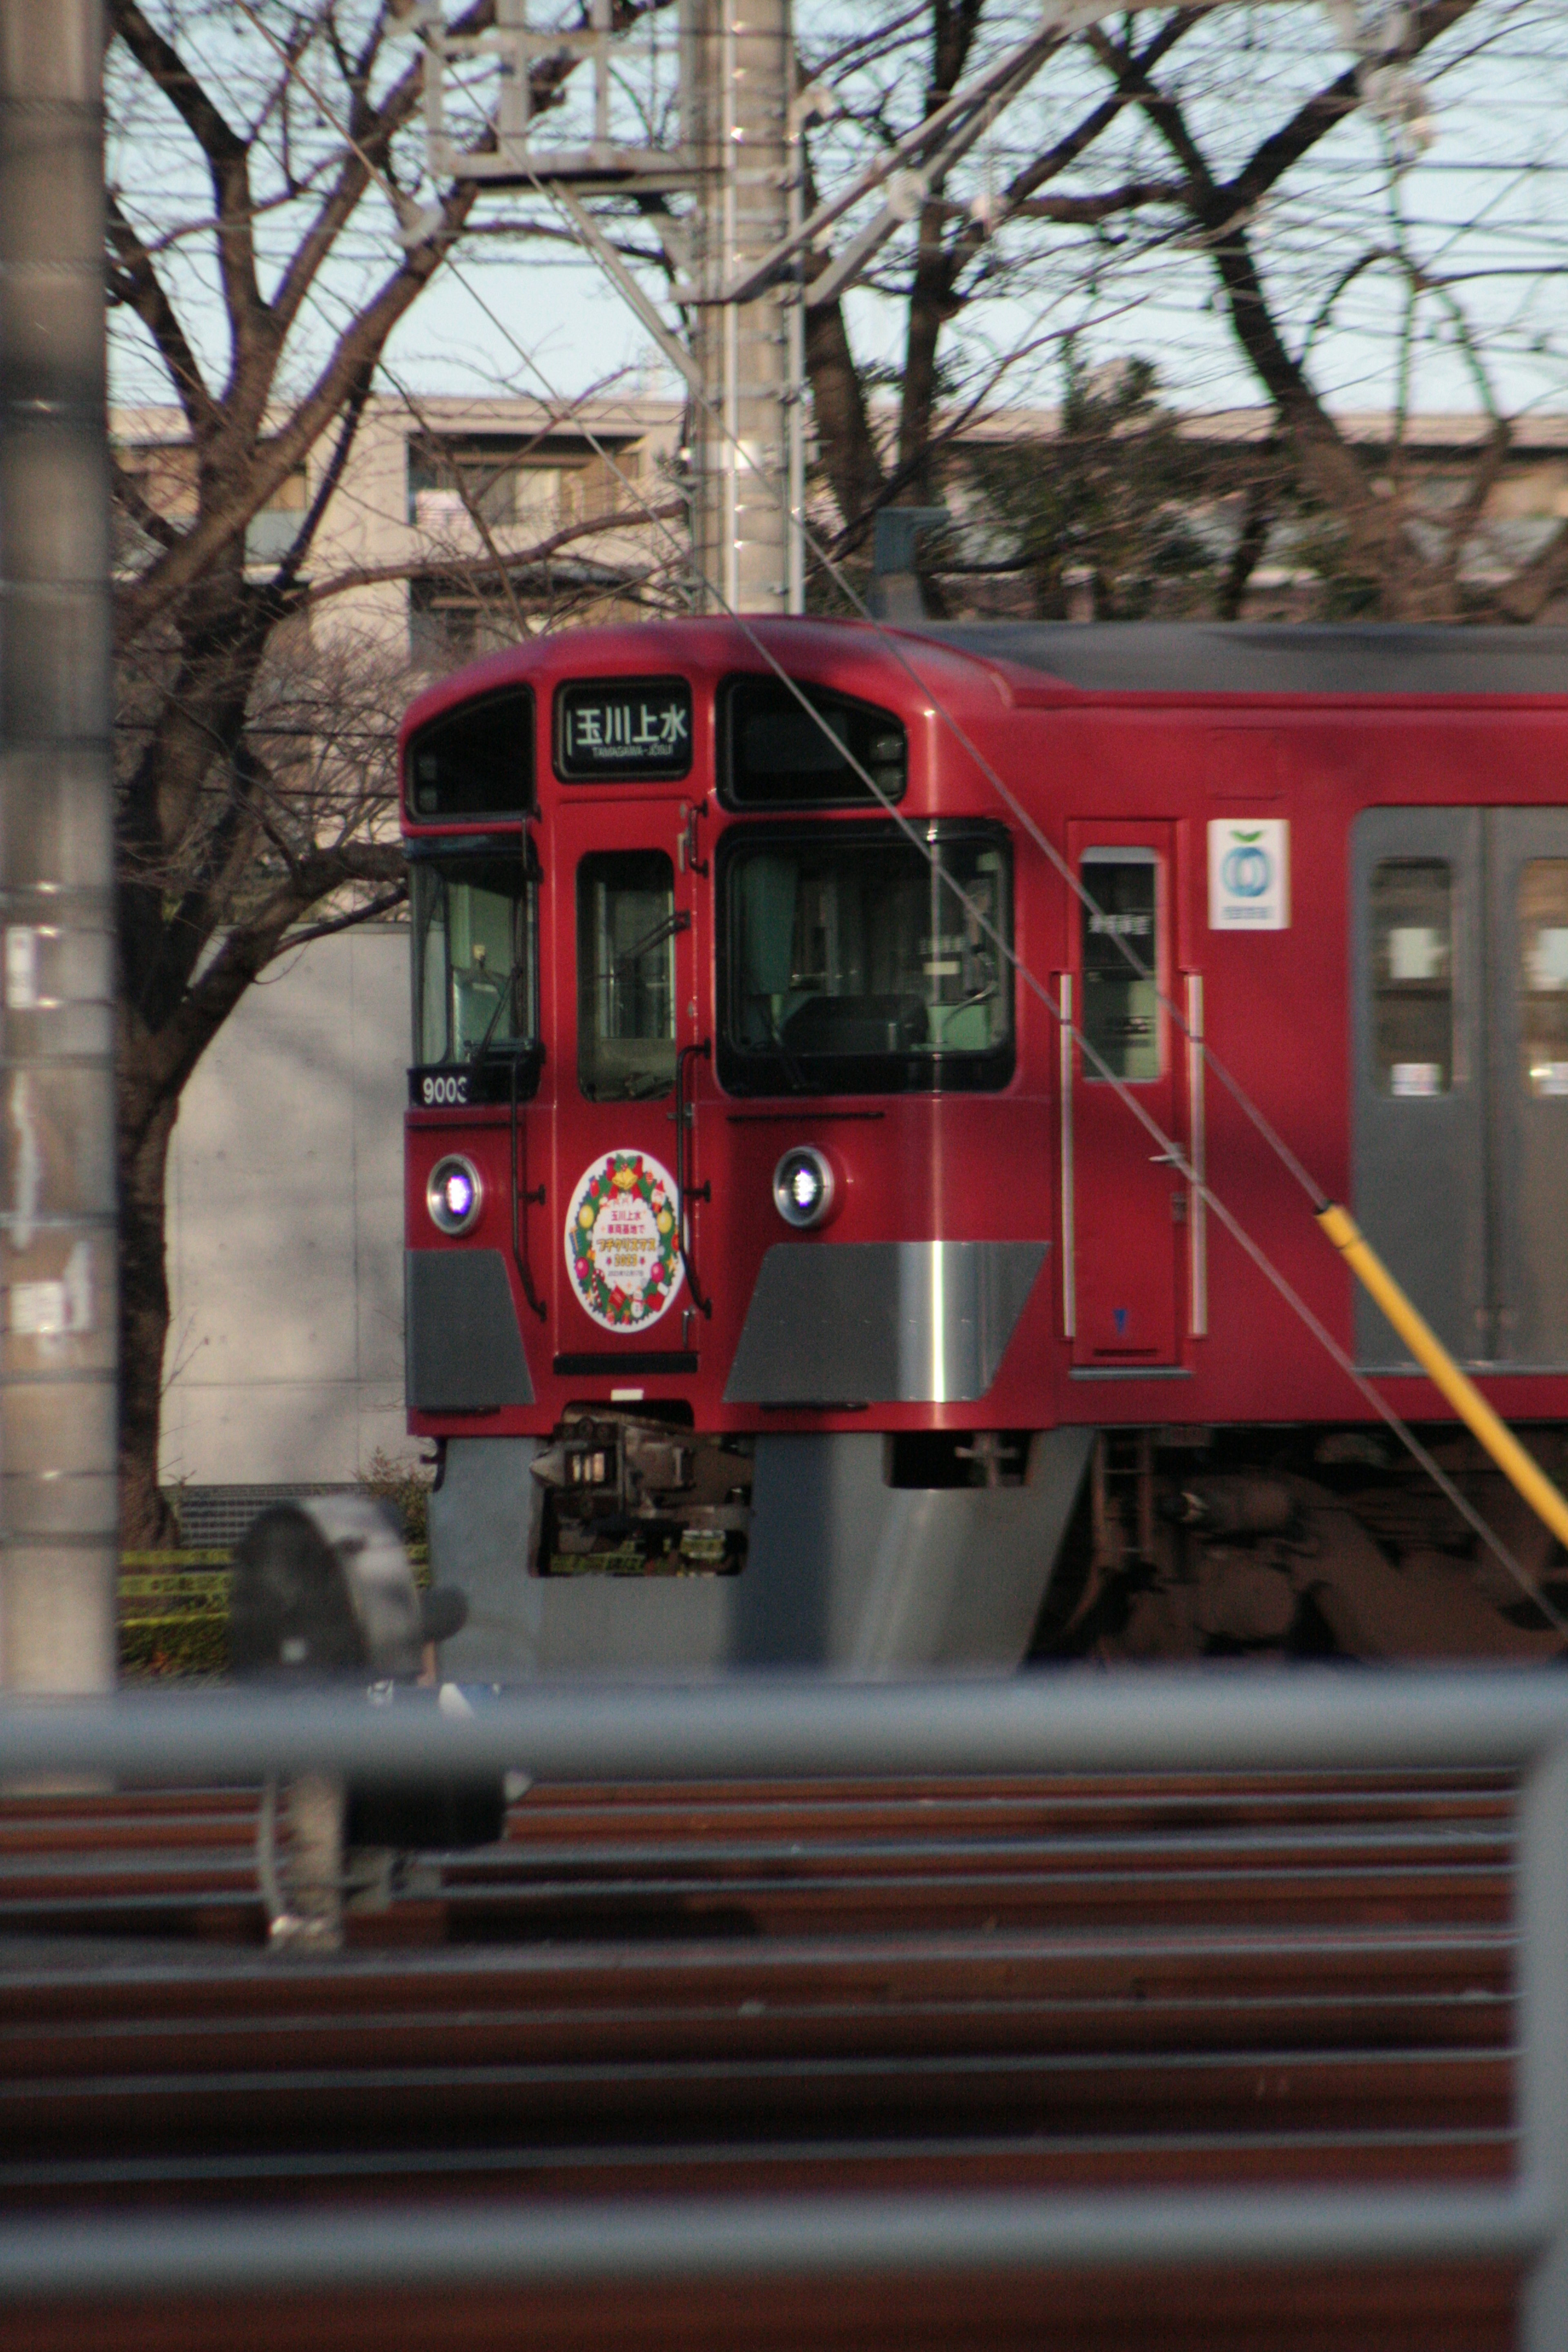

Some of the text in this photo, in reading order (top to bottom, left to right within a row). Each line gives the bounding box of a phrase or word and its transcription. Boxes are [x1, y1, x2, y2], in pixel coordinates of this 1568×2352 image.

[576, 704, 687, 744] 玉川上水
[611, 1211, 641, 1221] 玉川上水
